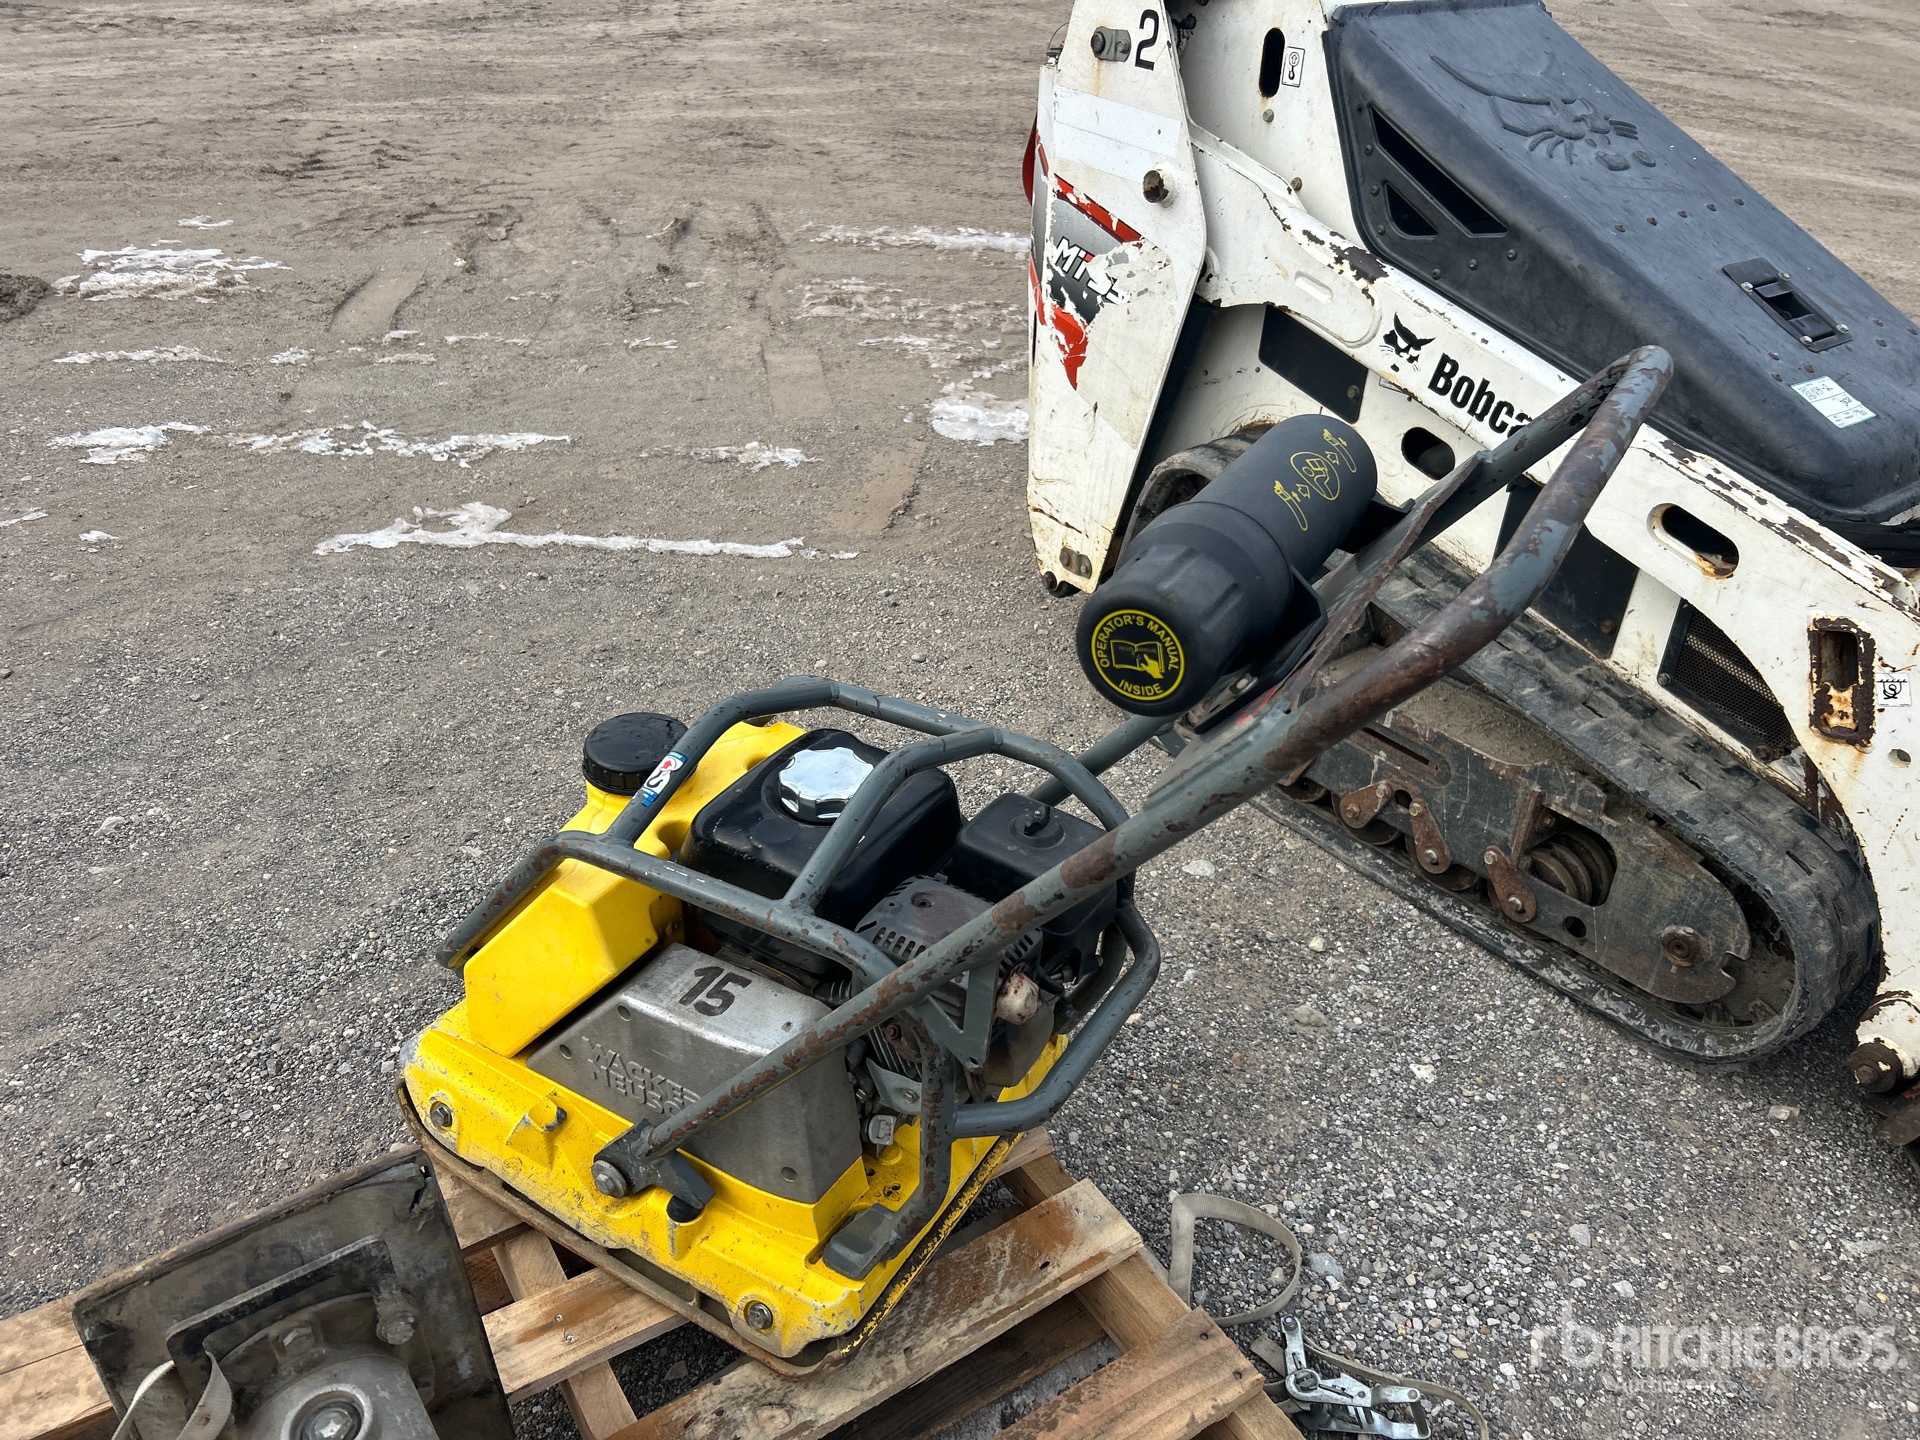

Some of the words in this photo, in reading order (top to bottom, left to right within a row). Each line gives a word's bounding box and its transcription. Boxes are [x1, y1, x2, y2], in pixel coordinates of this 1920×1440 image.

[1135, 8, 1159, 71] 2
[1427, 352, 1534, 438] Bobca
[1096, 614, 1145, 669] OPERATOR'S
[1146, 620, 1179, 671] MANUAL
[1118, 679, 1164, 696] INSIDE
[678, 965, 753, 1017] 15
[587, 1058, 684, 1117] NEUSO
